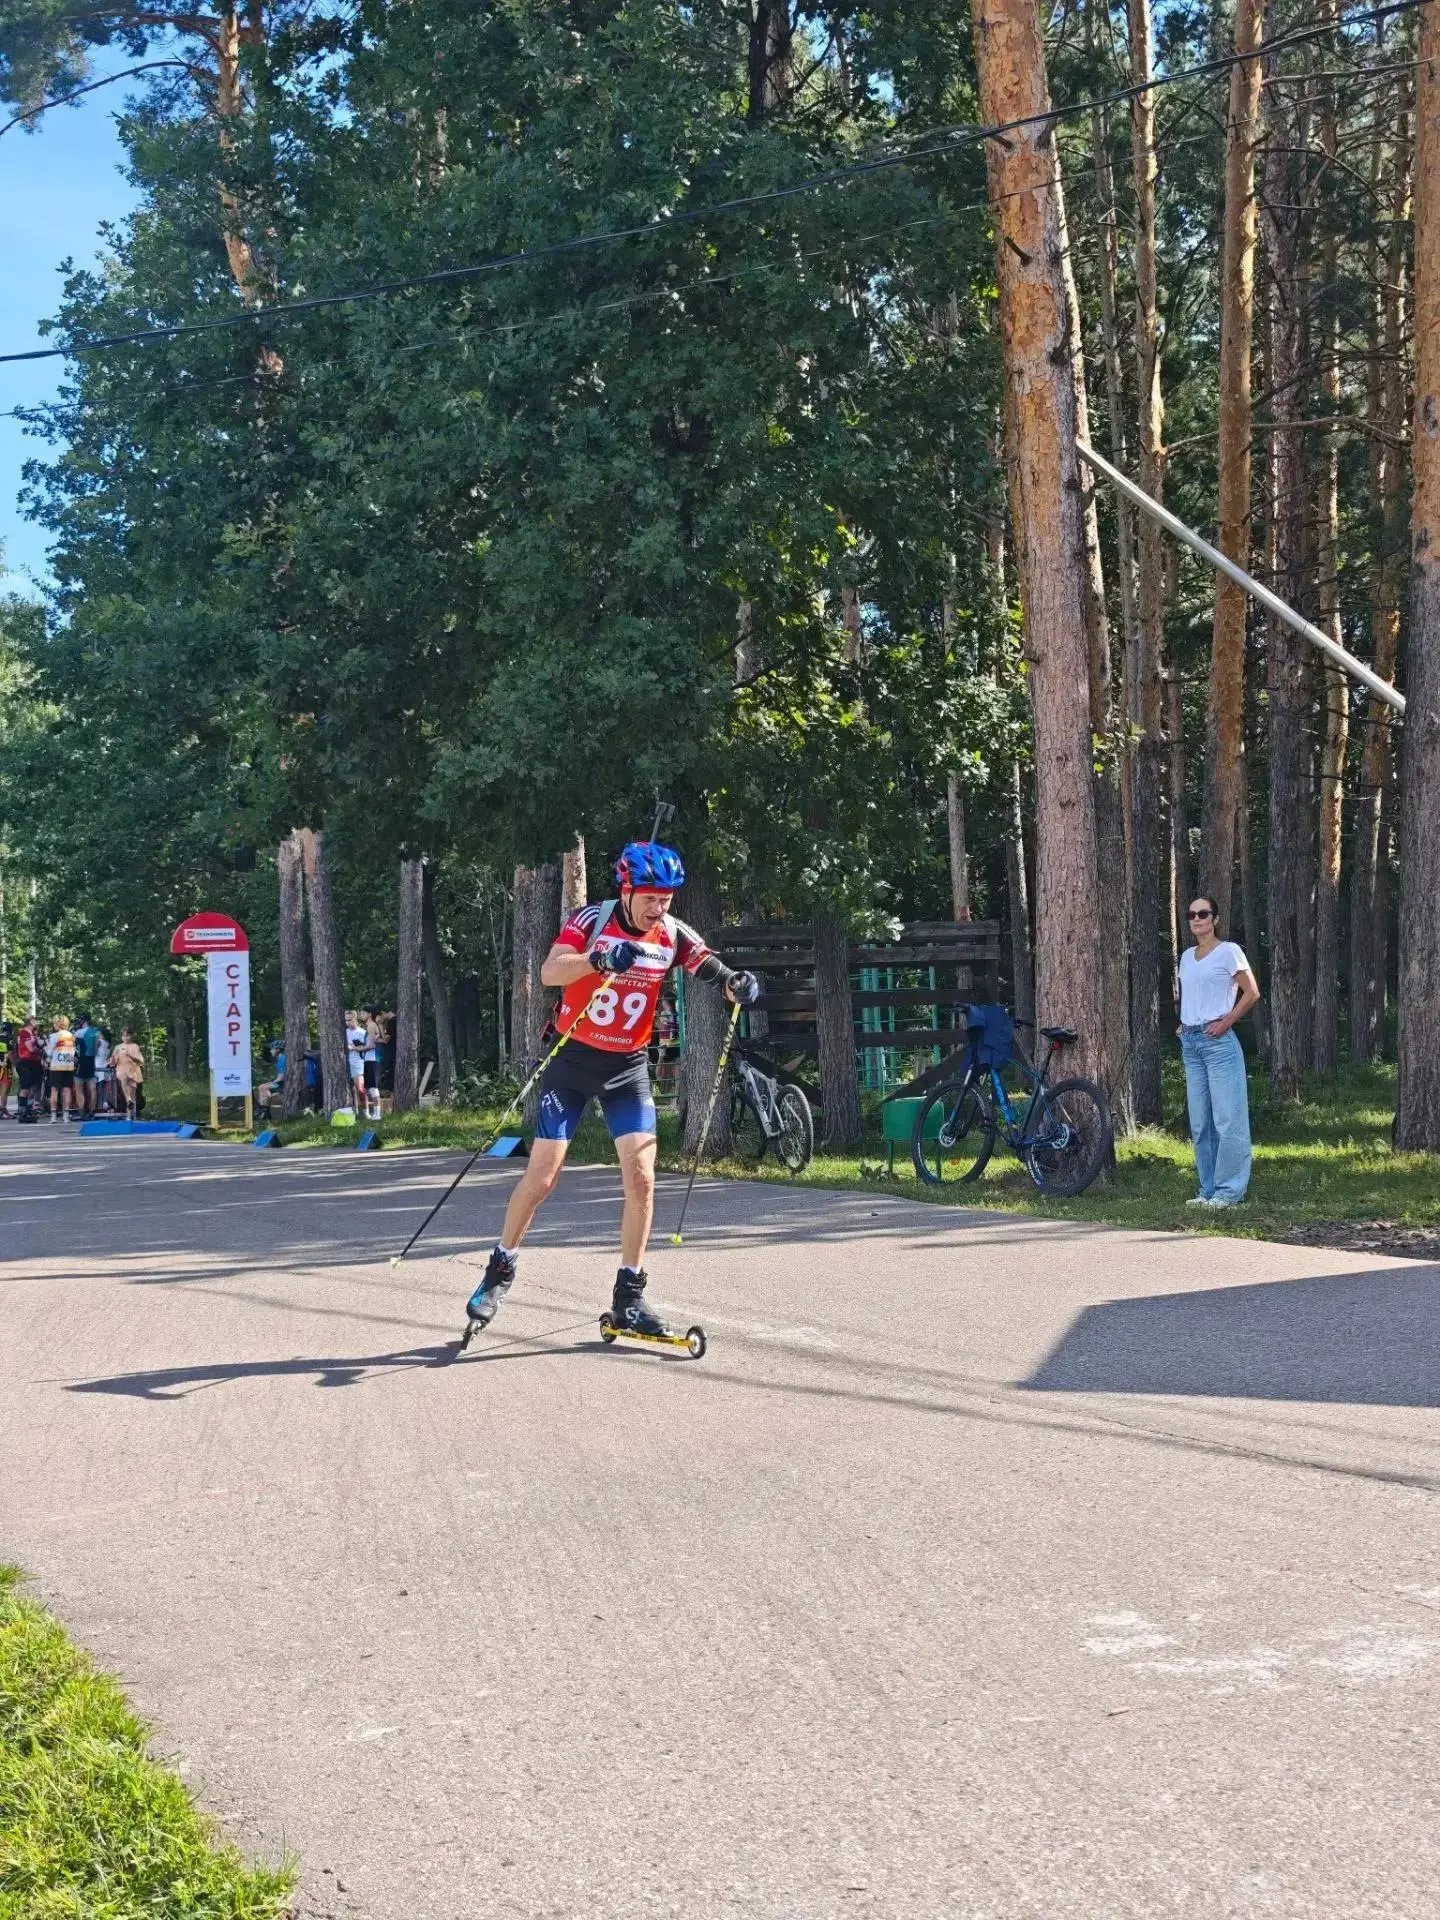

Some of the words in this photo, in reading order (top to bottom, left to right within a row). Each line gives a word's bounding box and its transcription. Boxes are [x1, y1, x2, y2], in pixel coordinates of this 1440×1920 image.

[226, 964, 242, 1056] СТАРТ
[588, 988, 647, 1030] 89
[550, 1090, 564, 1114] LUKOIL
